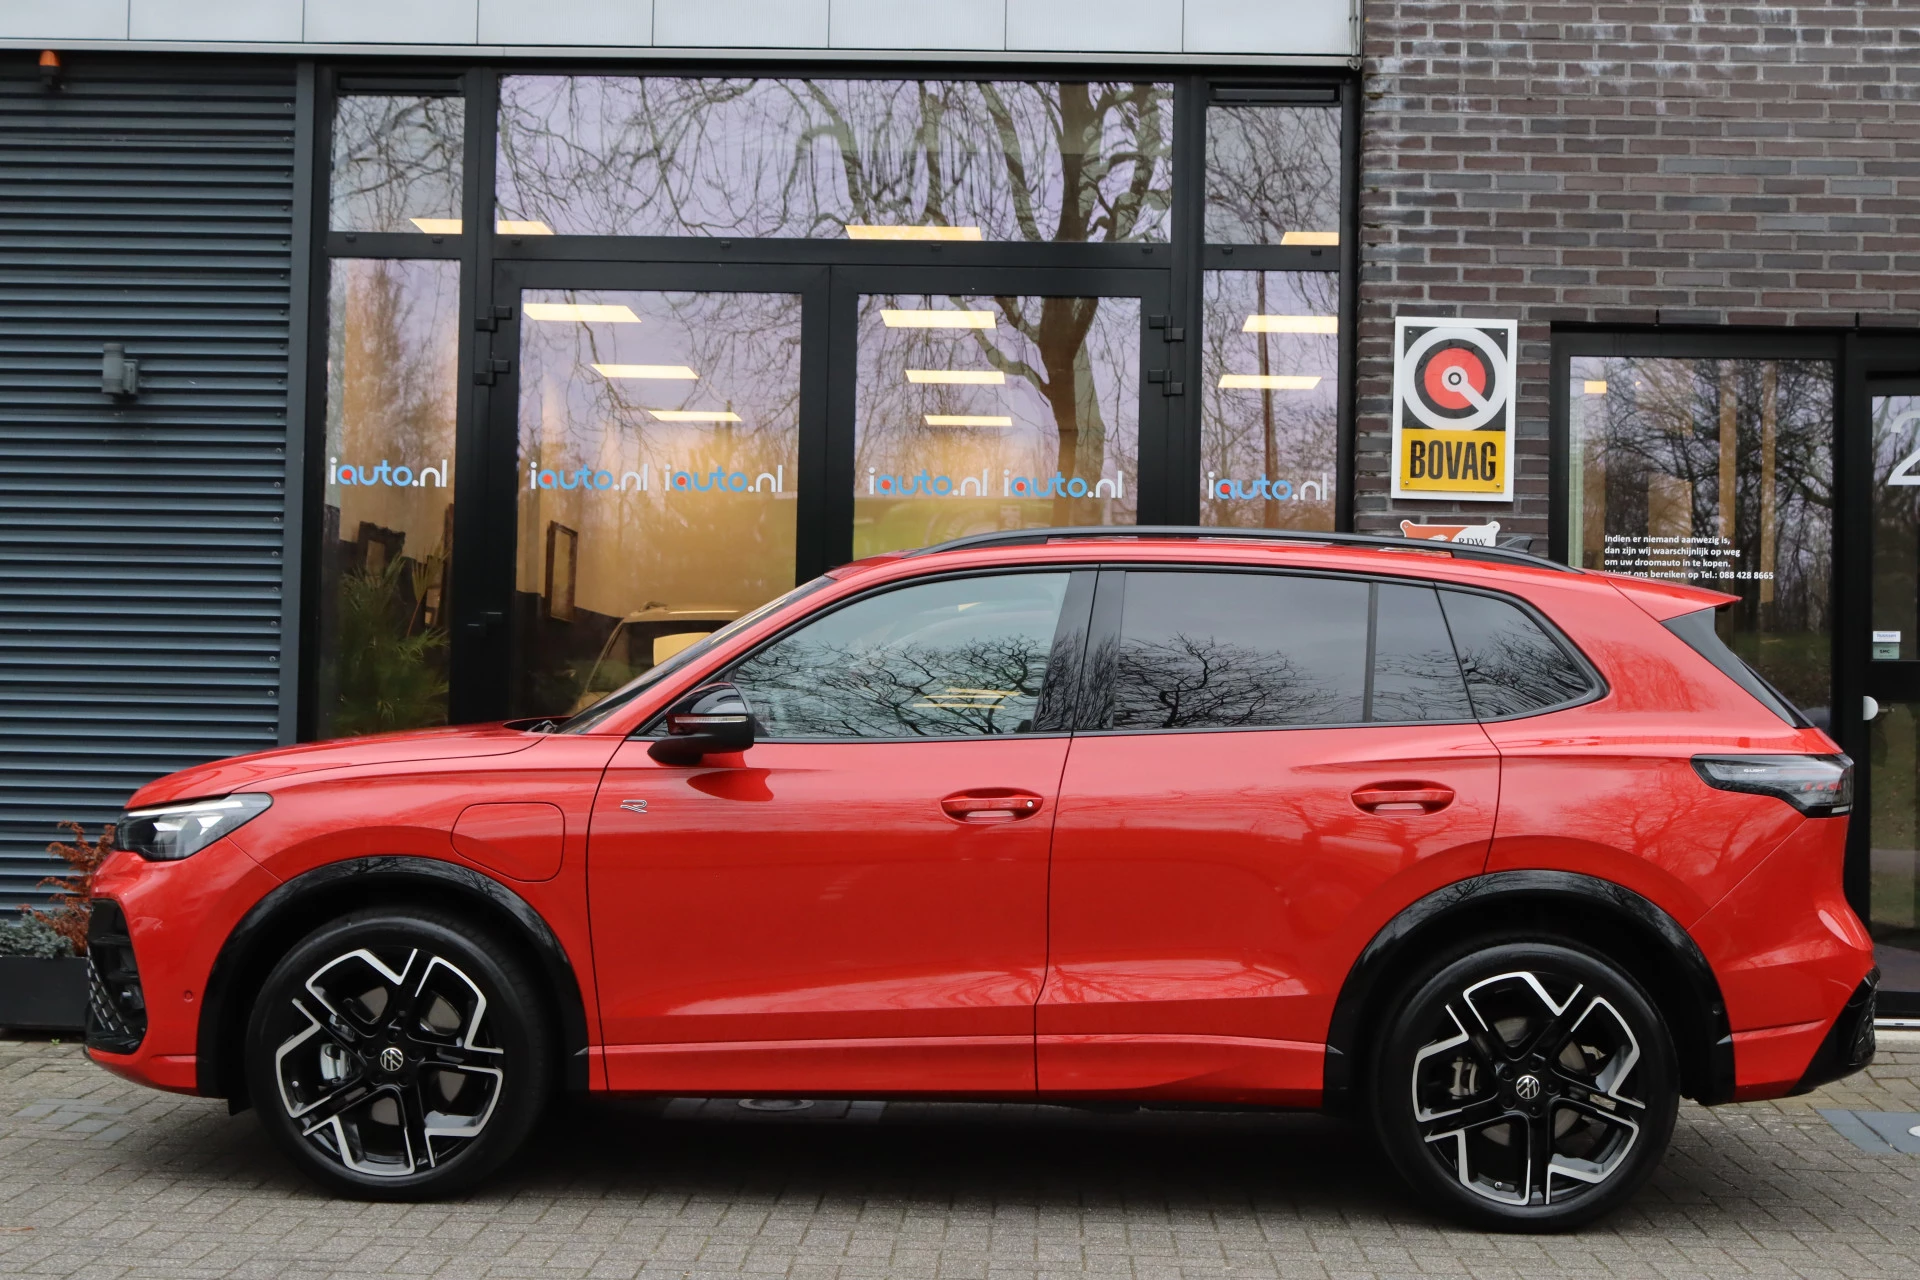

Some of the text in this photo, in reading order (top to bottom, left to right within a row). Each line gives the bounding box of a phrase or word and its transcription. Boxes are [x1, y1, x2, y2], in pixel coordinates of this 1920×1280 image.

[330, 457, 448, 488] iauto.nl
[1409, 439, 1497, 482] BOVAG
[530, 461, 648, 492] iauto.nl
[664, 463, 783, 493] iauto.nl
[868, 467, 988, 497] iauto.nl
[1003, 468, 1123, 498] iauto.nl
[1208, 471, 1328, 501] iauto.nl
[1458, 537, 1487, 546] RDW
[1604, 534, 1631, 543] Indien
[1643, 535, 1680, 543] niemand
[1681, 536, 1720, 545] aanwezig
[1721, 536, 1731, 545] is,
[1604, 546, 1741, 558] dan zijn wij waarschijnlijk op weg
[1634, 558, 1681, 566] droomauto
[1682, 559, 1691, 567] in
[1692, 559, 1701, 567] te
[1702, 558, 1731, 569] kopen.
[1650, 570, 1686, 578] bereiken
[1687, 572, 1699, 580] op
[1700, 570, 1718, 579] Tel.:
[1719, 571, 1735, 579] 088
[1736, 571, 1752, 580] 428
[1753, 571, 1774, 580] 8665
